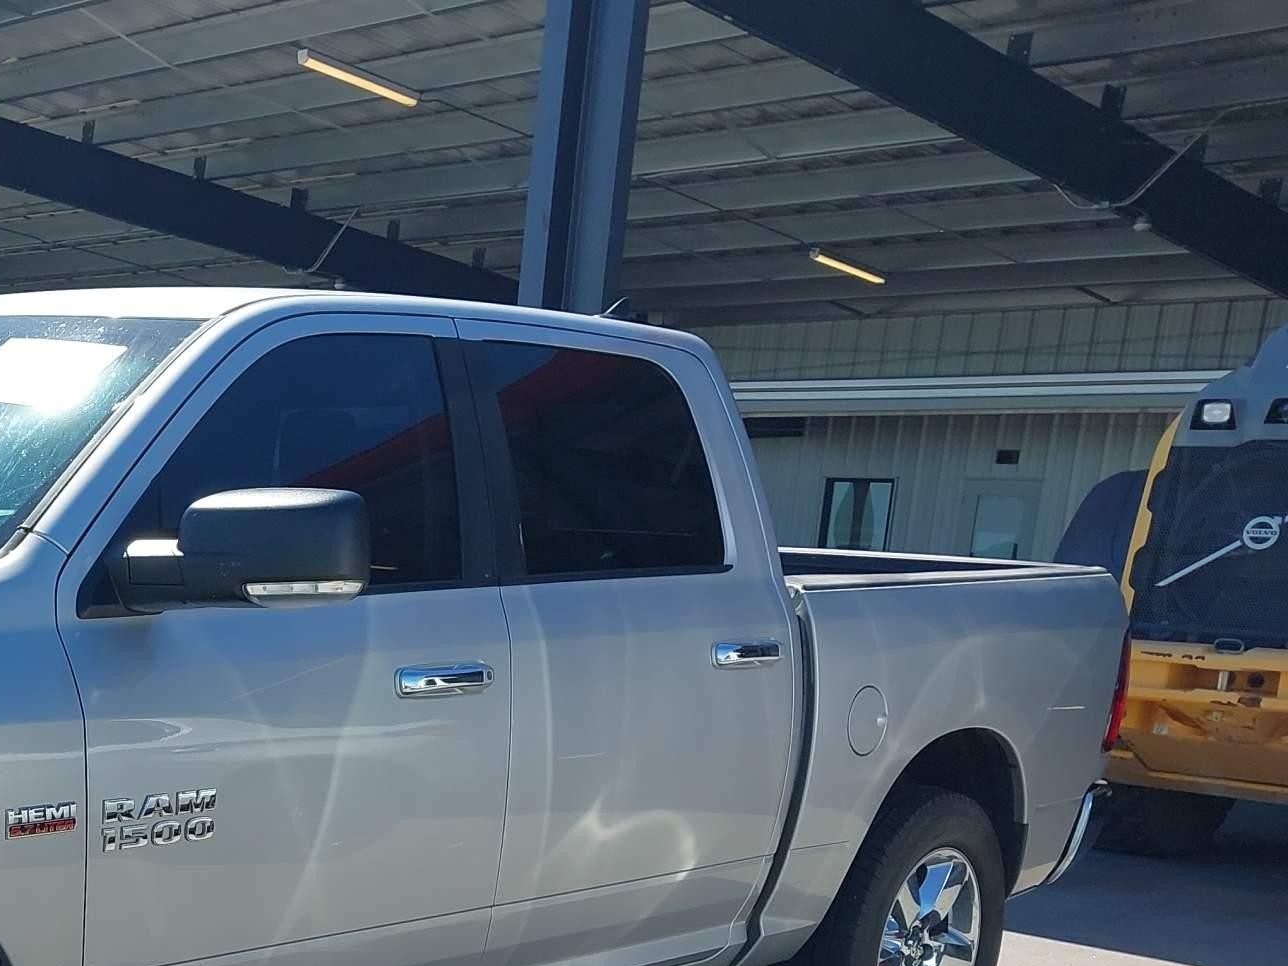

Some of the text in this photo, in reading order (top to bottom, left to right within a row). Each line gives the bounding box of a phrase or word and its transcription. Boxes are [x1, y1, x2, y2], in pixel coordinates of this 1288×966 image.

[6, 802, 77, 825] HEMI
[102, 788, 217, 824] RAM
[102, 816, 215, 852] 1500
